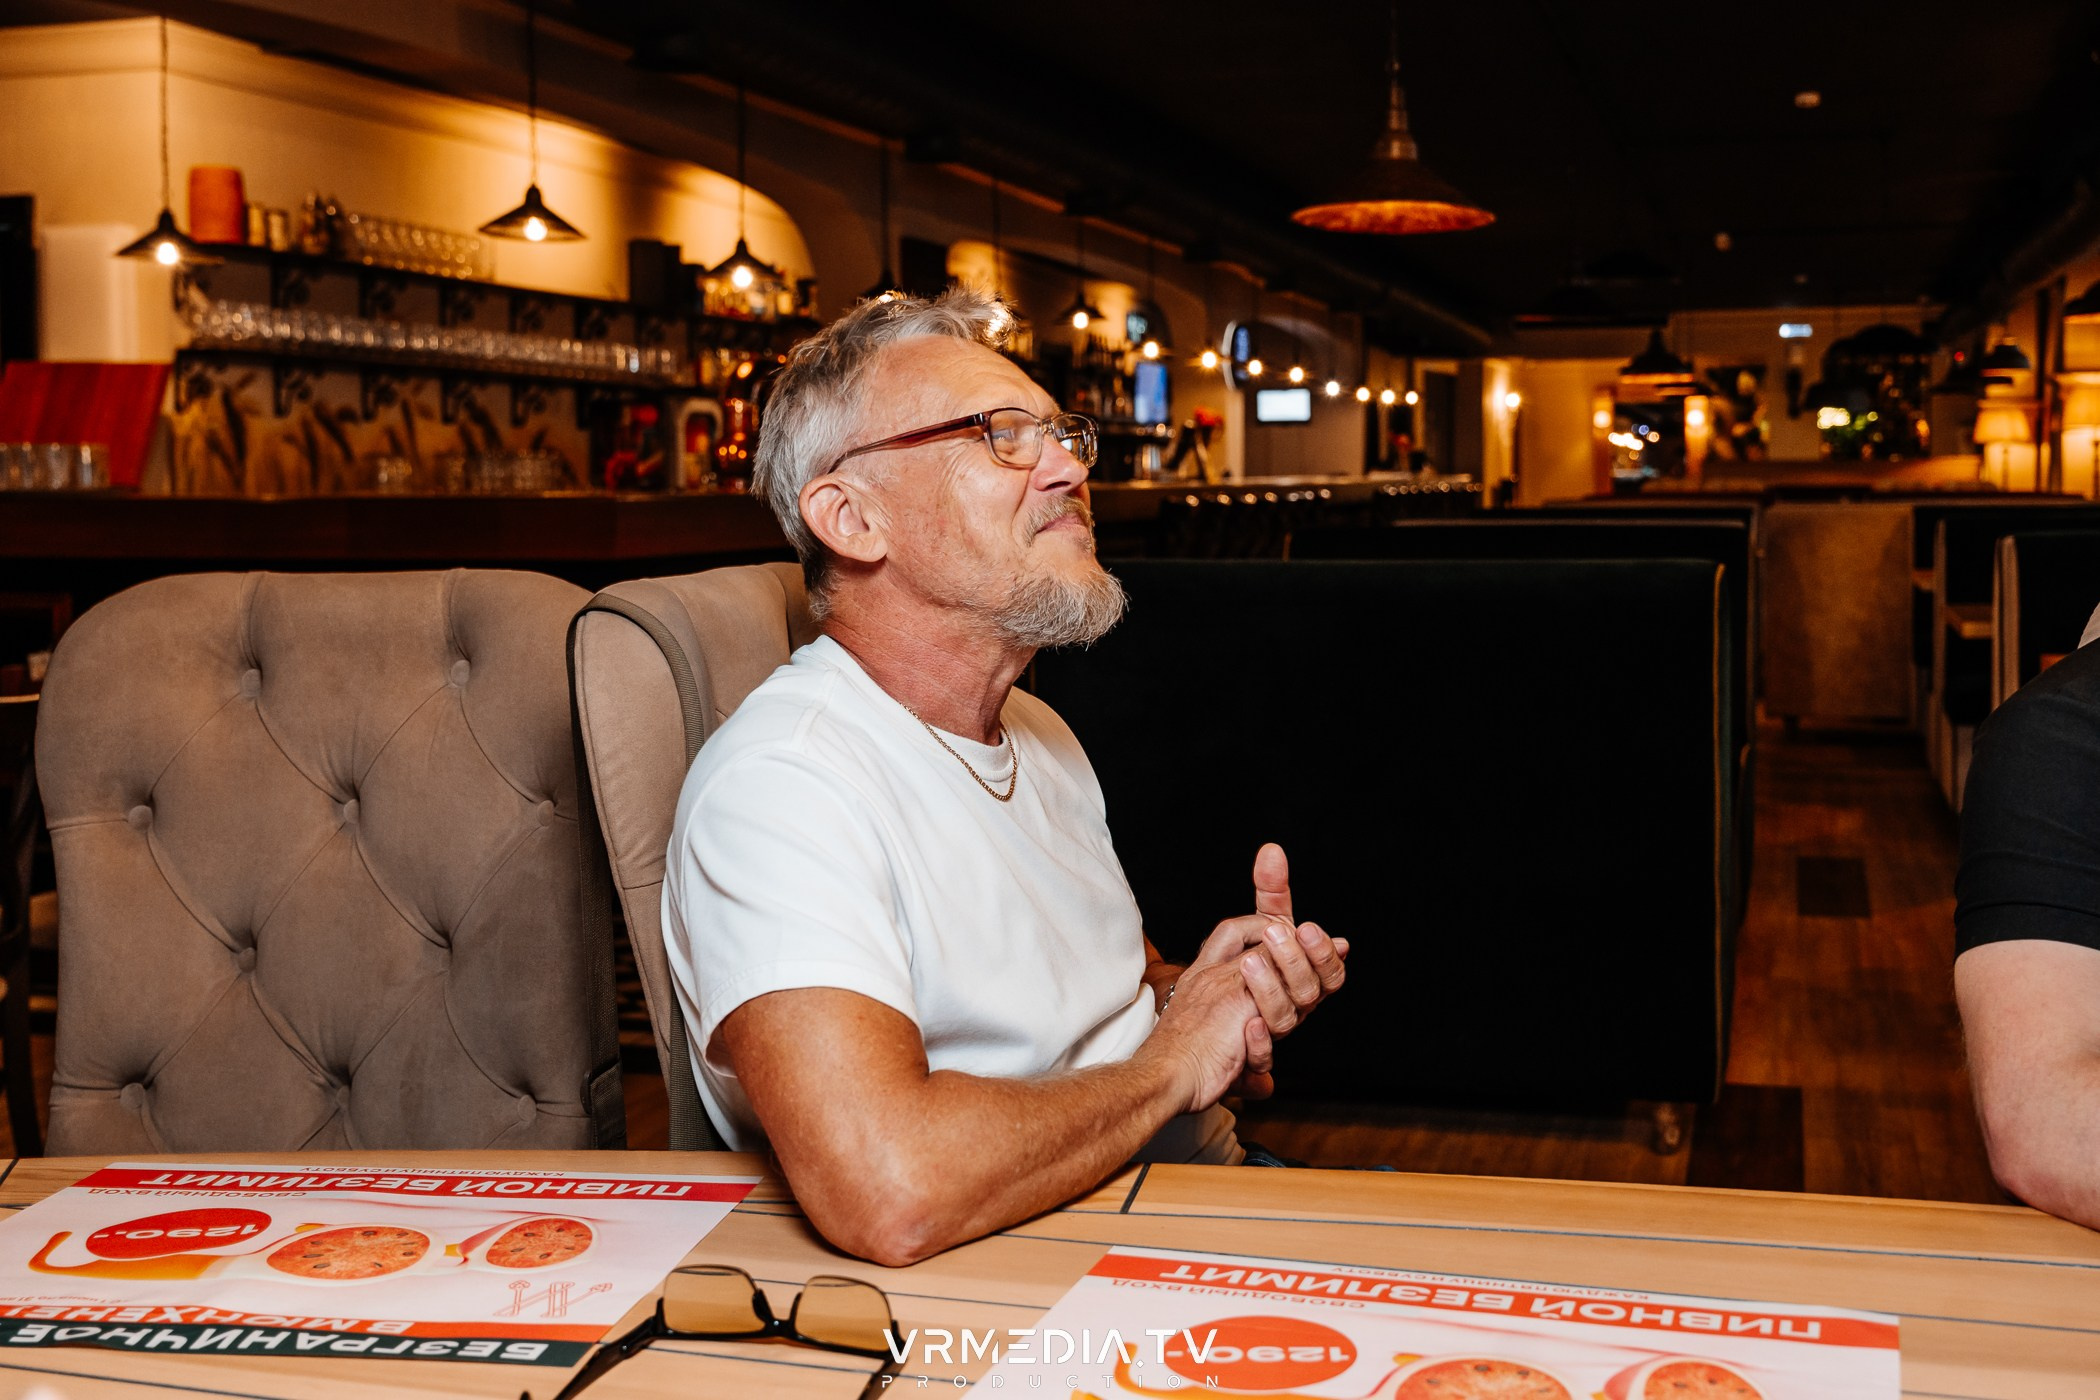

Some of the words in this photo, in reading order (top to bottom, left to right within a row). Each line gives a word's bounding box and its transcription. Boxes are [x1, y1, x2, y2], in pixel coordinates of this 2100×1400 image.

[301, 1166, 384, 1174] СУББОТУ
[400, 1168, 482, 1177] ПЯТНИЦУ
[485, 1170, 565, 1178] КАЖДУЮ
[138, 1173, 447, 1191] БЕЗЛИМИТ
[451, 1179, 693, 1196] ПИВНОЙ
[88, 1188, 153, 1196] ВХОД
[155, 1190, 307, 1198] СВОБОДНЫЙ
[1332, 1266, 1428, 1282] СУББОТУ
[1112, 1278, 1183, 1292] ВХОД
[1159, 1265, 1515, 1310] БЕЗЛИМИТ
[1449, 1277, 1549, 1292] ПЯТНИЦУ
[1188, 1286, 1365, 1309] СВОБОДНЫЙ
[1530, 1297, 1821, 1339] ПИВНОЙ
[365, 1321, 416, 1334] В
[9, 1323, 549, 1361] БЕЗГРАНИЧНОЕ
